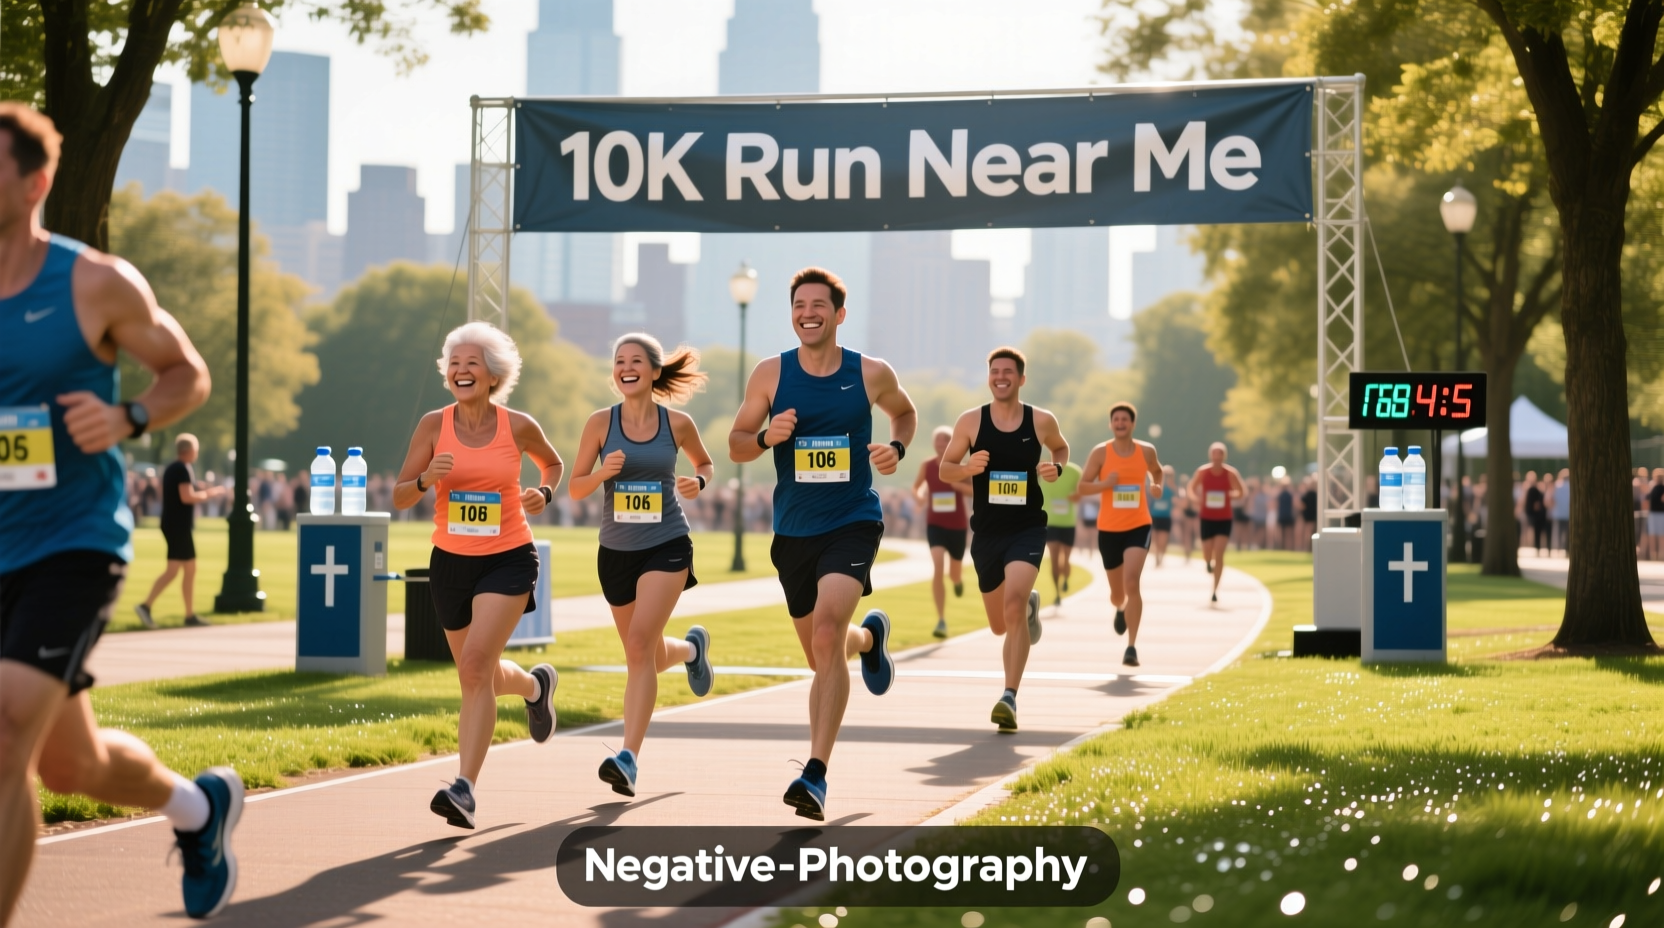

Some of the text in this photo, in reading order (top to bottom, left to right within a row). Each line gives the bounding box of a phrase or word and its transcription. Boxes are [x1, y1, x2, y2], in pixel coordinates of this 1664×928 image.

[560, 120, 1262, 202] 10K Run Near Me
[625, 494, 651, 511] 106
